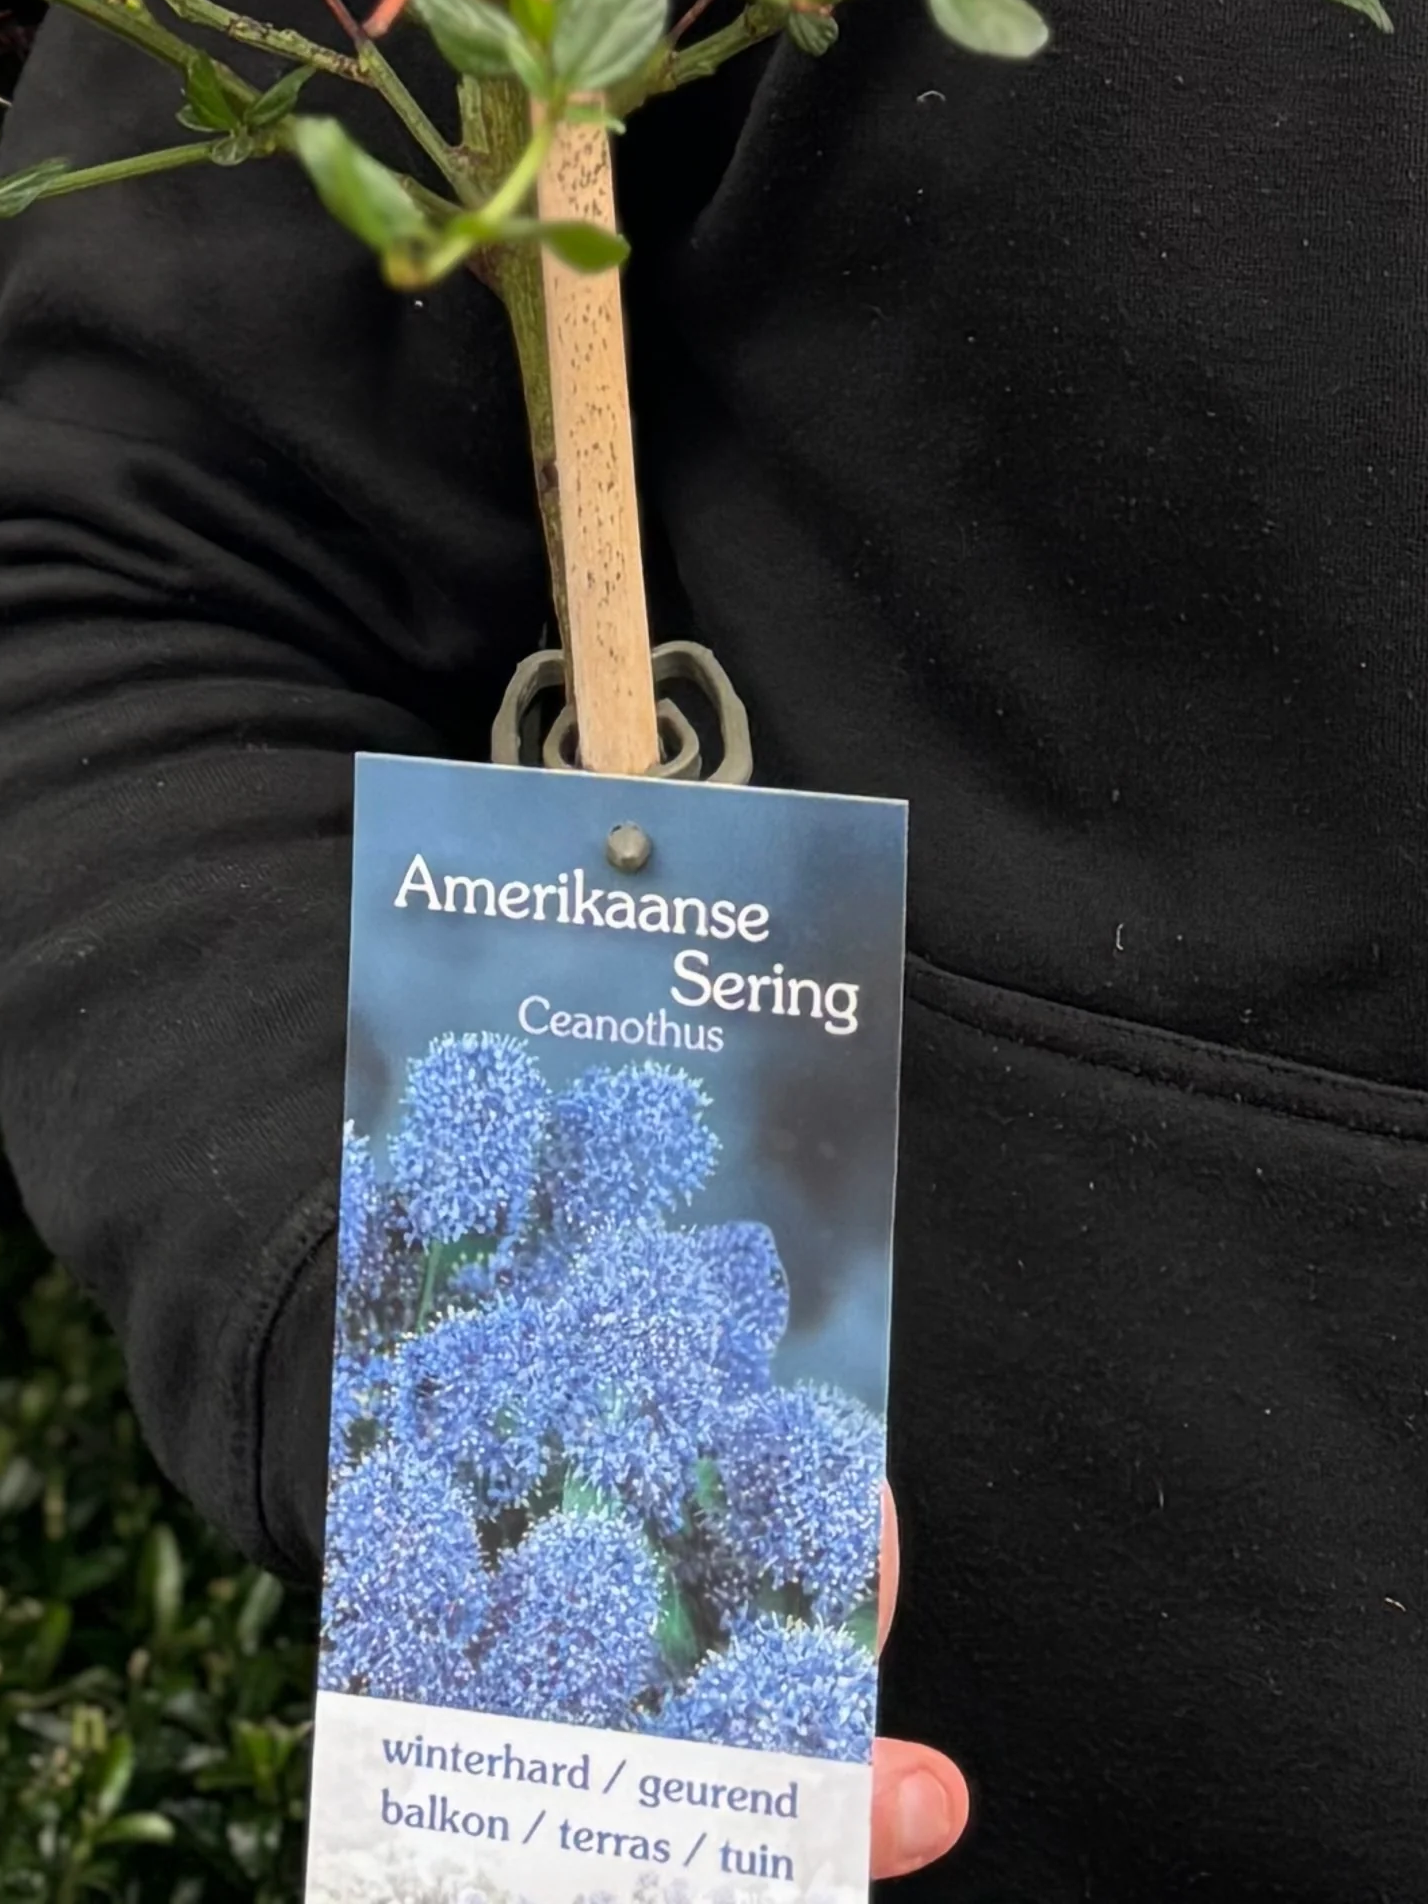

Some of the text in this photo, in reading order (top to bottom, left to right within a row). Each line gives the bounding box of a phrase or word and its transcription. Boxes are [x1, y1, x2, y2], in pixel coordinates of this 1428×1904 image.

[393, 853, 770, 942] Amerikaanse
[518, 995, 724, 1053] Ceanothus
[671, 949, 860, 1035] Sering
[382, 1735, 590, 1790] winterhard
[638, 1772, 799, 1819] geurend
[381, 1789, 509, 1842] balkon
[559, 1819, 670, 1863] terras
[720, 1839, 794, 1880] tuin
